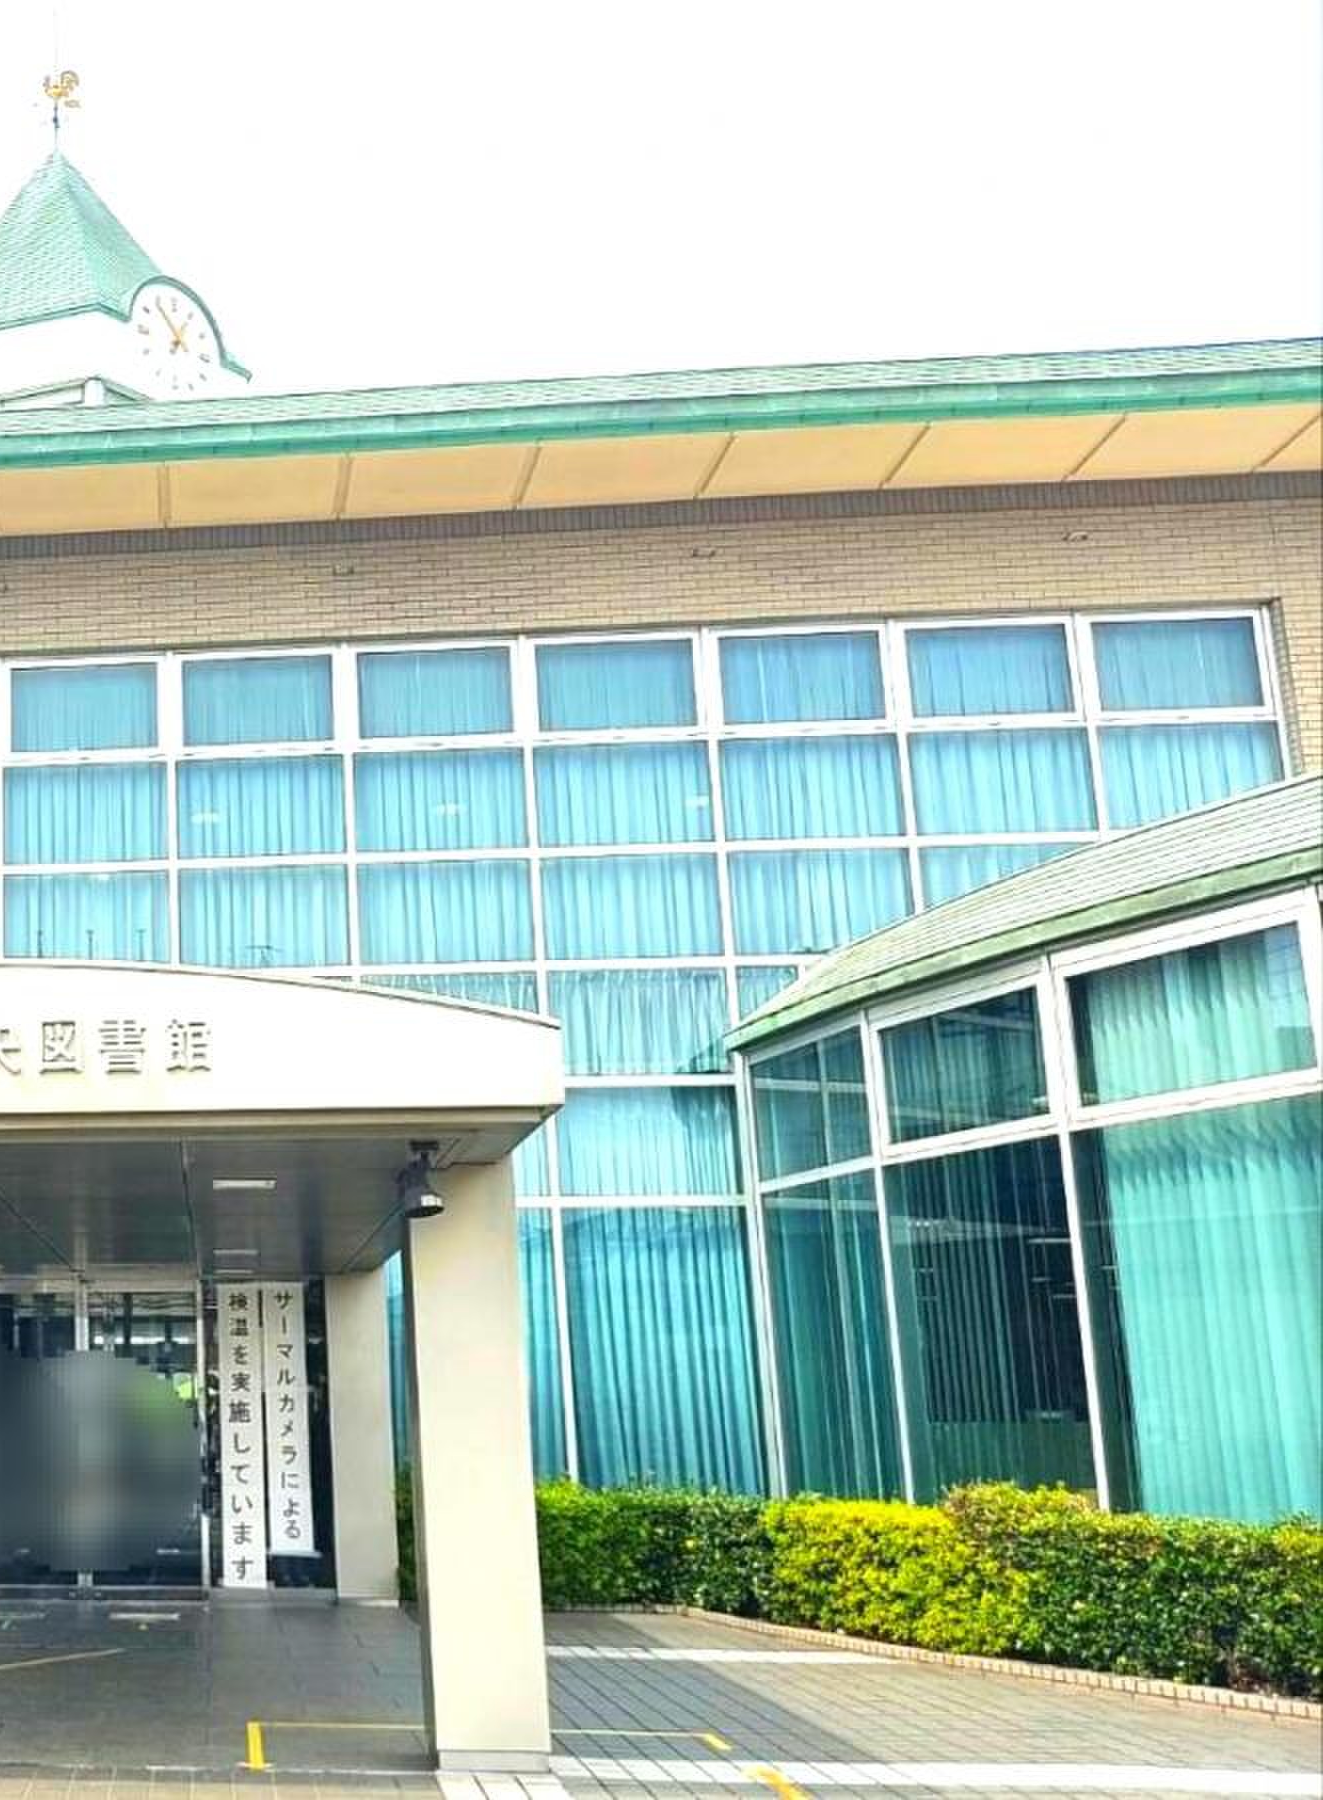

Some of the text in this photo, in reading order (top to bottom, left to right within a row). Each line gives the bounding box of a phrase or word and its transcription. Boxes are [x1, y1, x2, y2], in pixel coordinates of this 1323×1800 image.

[228, 1293, 254, 1580] 検温を実施しています
[274, 1291, 302, 1540] サーマルカメラによる
